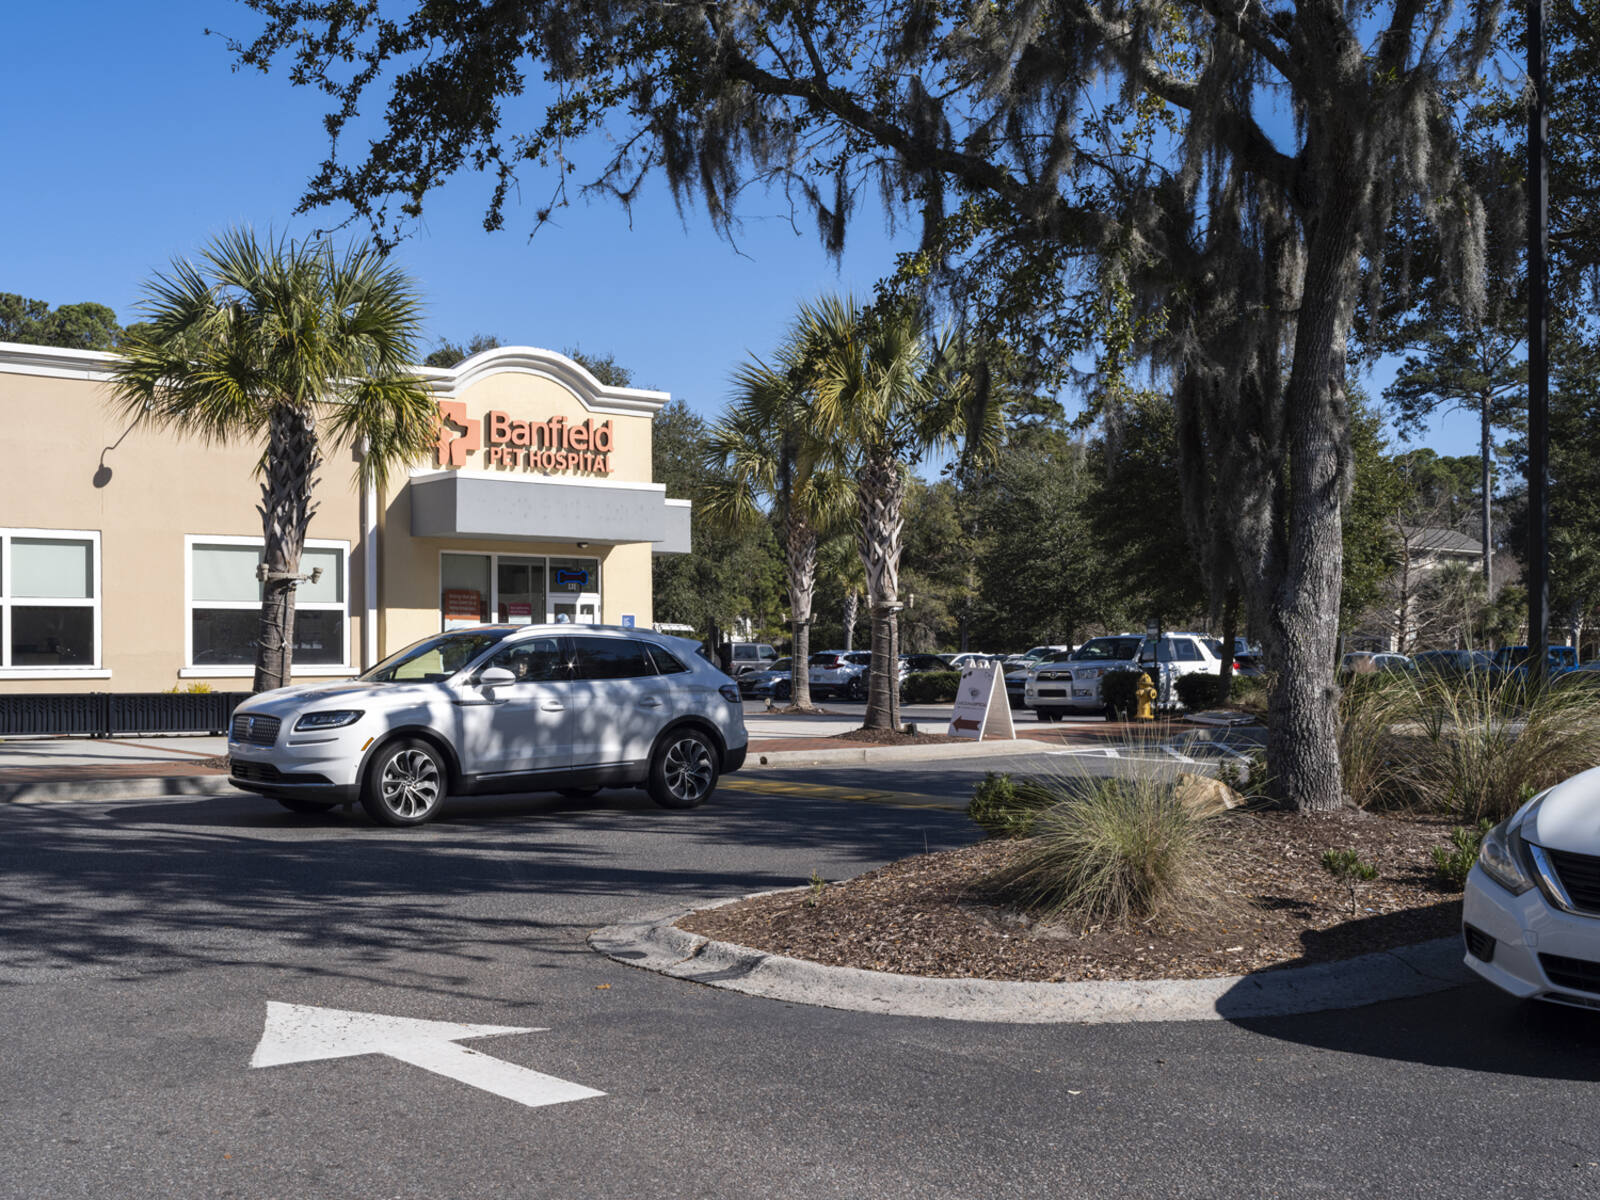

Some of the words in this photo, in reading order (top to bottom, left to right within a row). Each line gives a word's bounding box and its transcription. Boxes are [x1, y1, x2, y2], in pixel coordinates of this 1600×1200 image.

[489, 410, 614, 451] Banfield
[490, 447, 523, 466] PET
[530, 451, 614, 473] HOSPITAL
